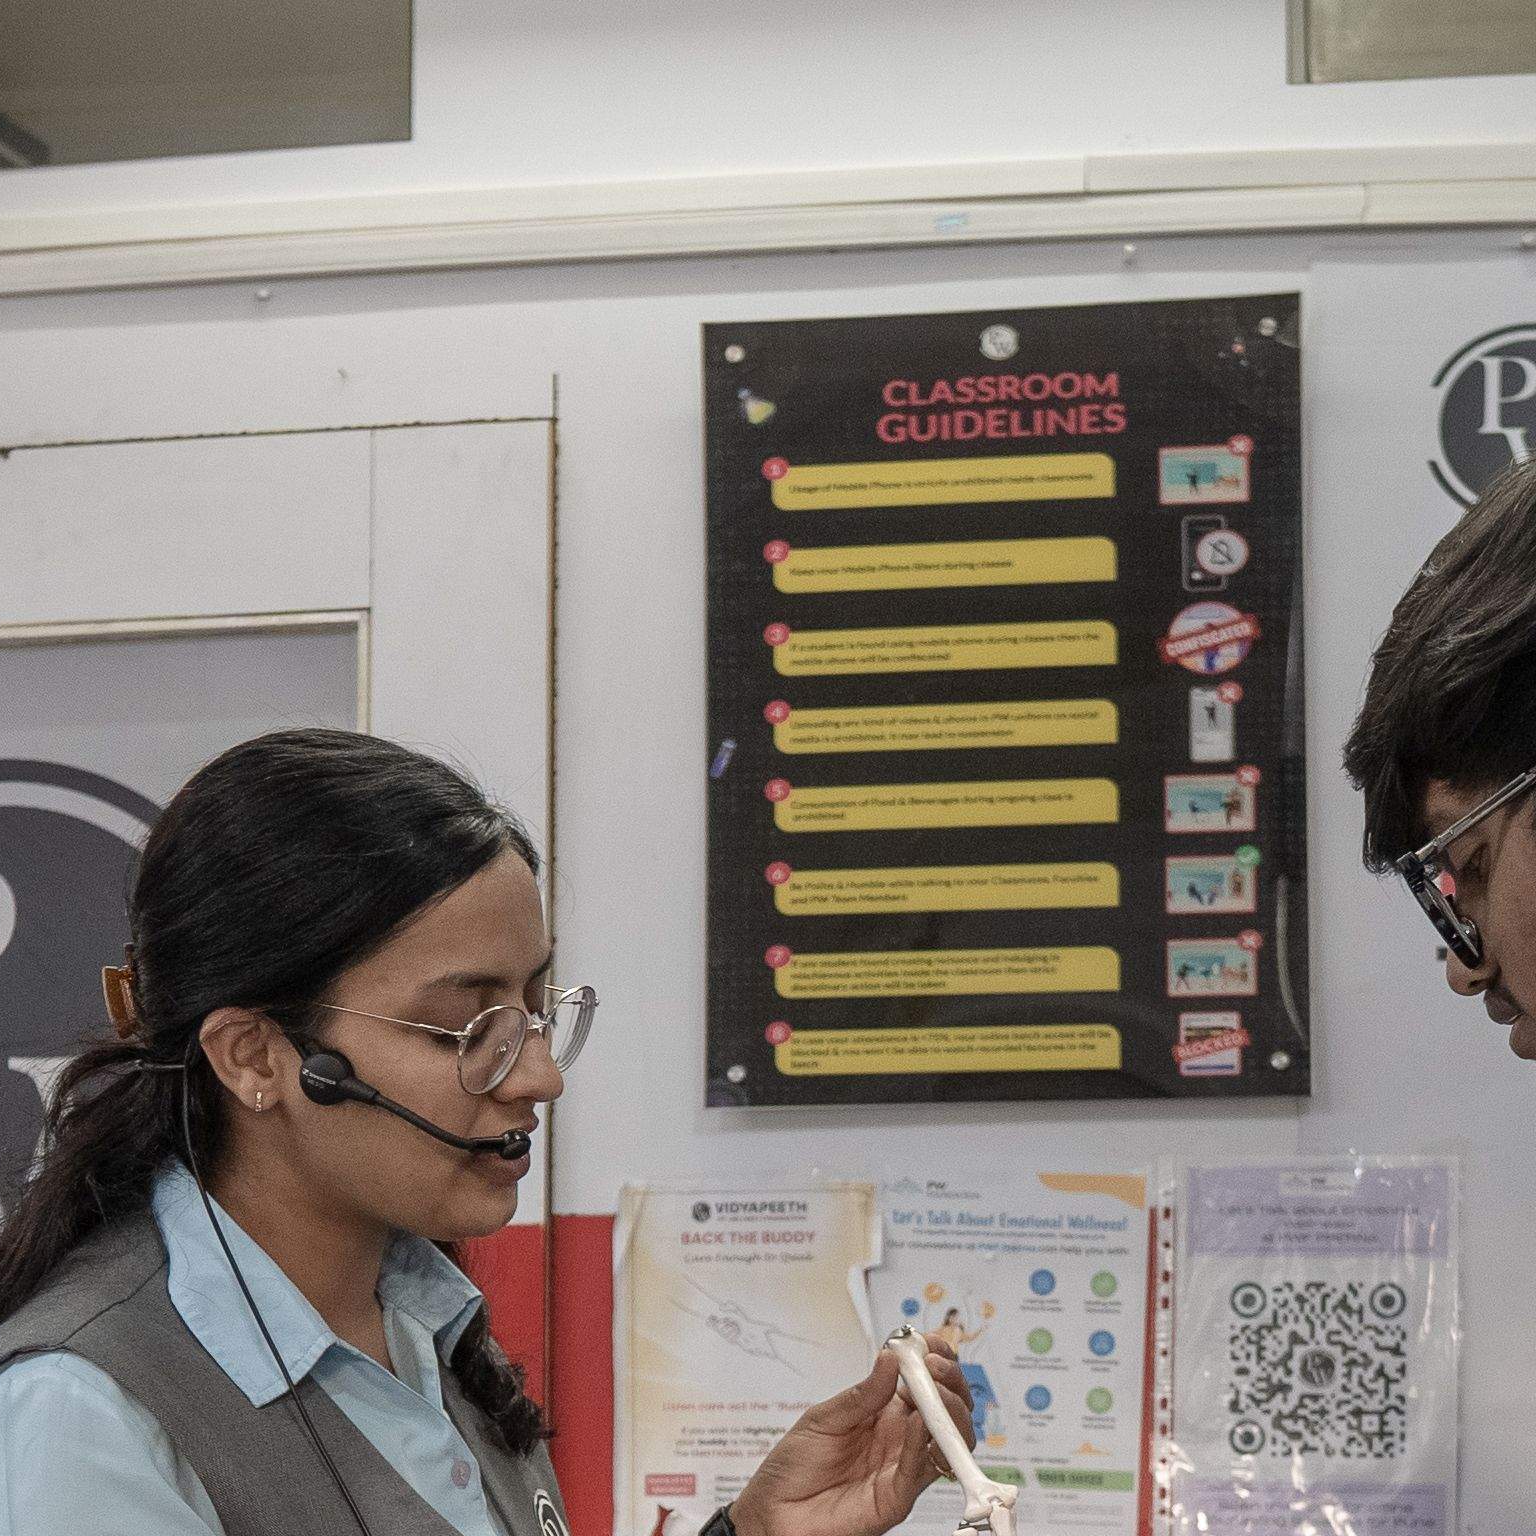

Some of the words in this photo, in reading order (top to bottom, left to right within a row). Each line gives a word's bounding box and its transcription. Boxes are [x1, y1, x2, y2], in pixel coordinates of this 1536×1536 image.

[883, 372, 1119, 405] CLASSROOM
[876, 404, 1128, 443] GUIDELINES
[715, 1201, 808, 1213] VIDYAPEETH
[927, 1209, 952, 1225] Talk
[956, 1211, 994, 1226] About
[999, 1212, 1062, 1229] Emotional
[681, 1231, 725, 1245] BACK
[730, 1231, 757, 1244] THE
[762, 1231, 816, 1244] BUDDY
